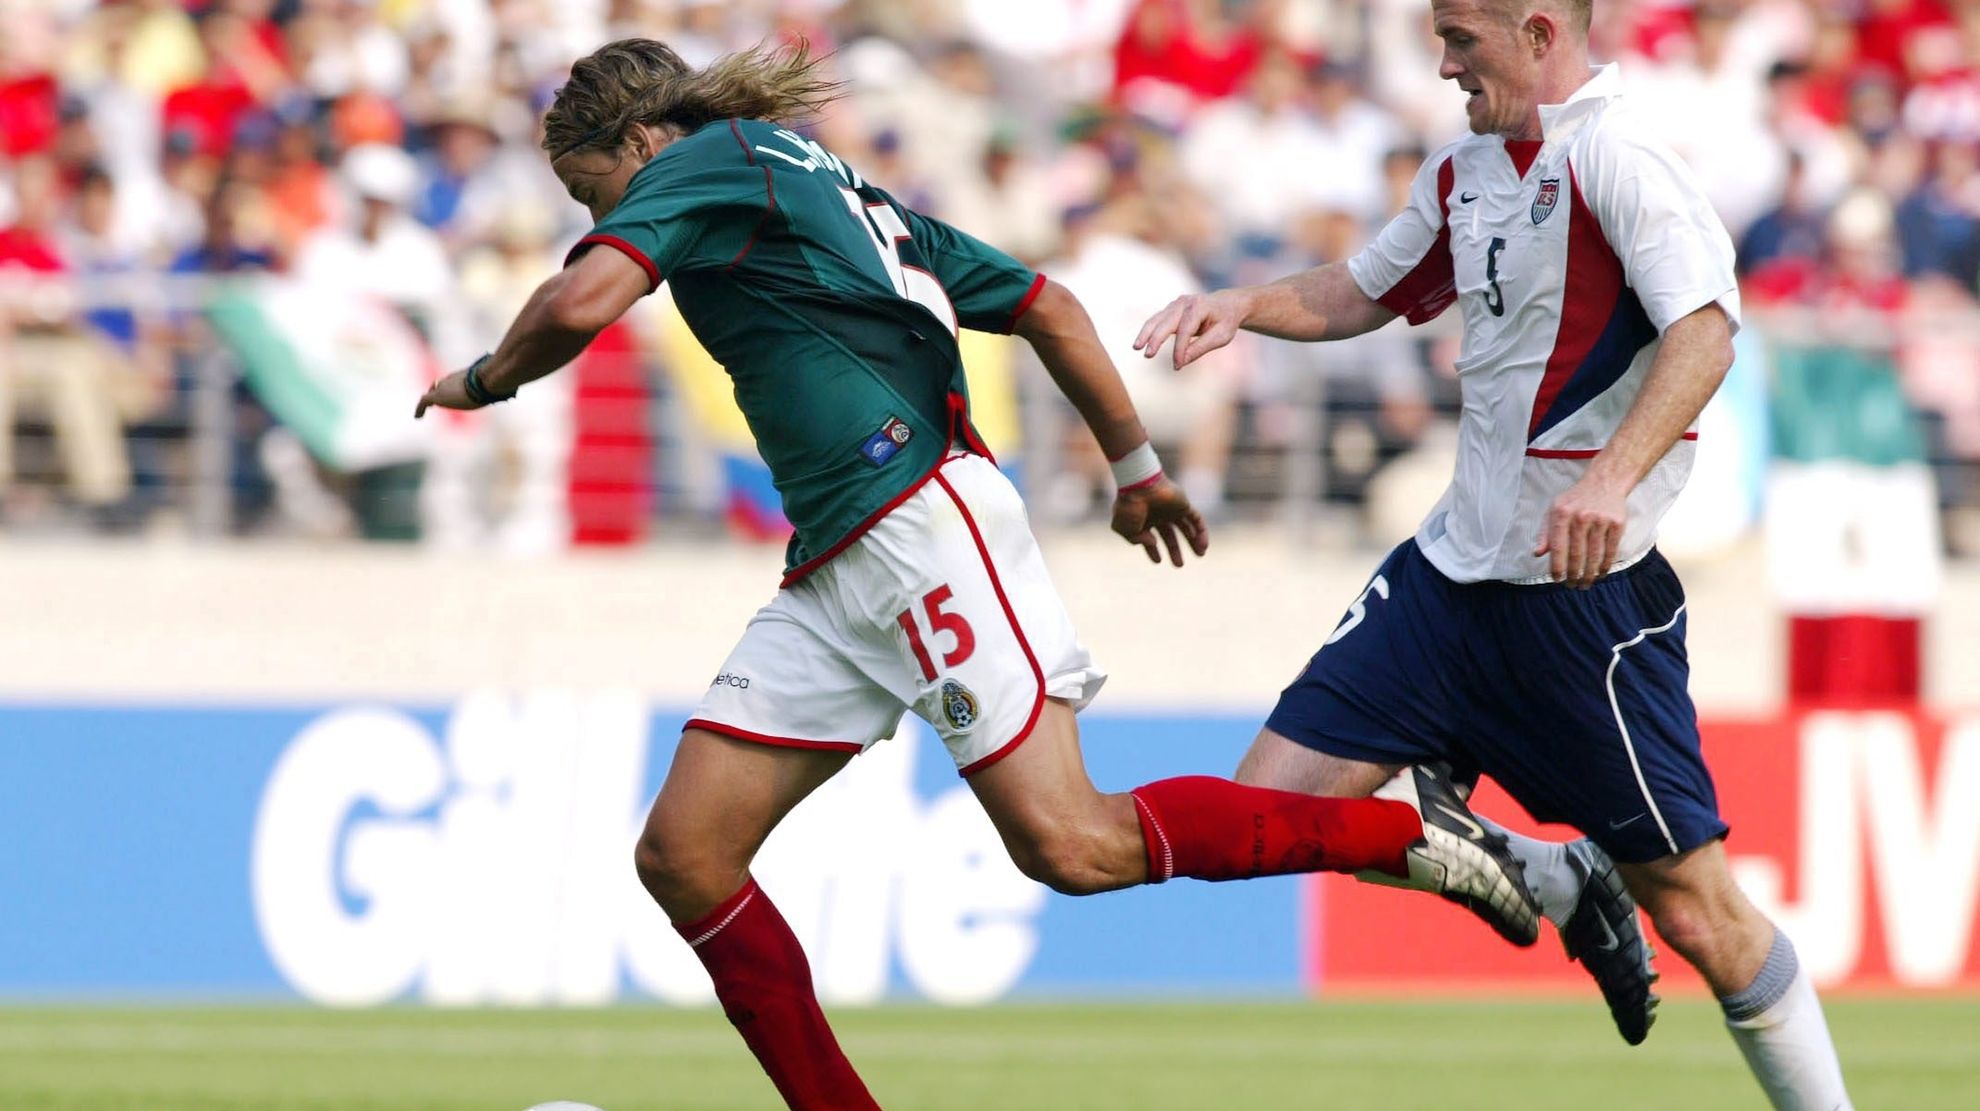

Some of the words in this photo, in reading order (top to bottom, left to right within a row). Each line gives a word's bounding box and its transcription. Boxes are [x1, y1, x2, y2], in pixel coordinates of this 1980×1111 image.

[1483, 237, 1507, 317] 5
[897, 582, 976, 685] 15
[1325, 574, 1390, 646] 5
[252, 690, 1045, 1004] Gilltte
